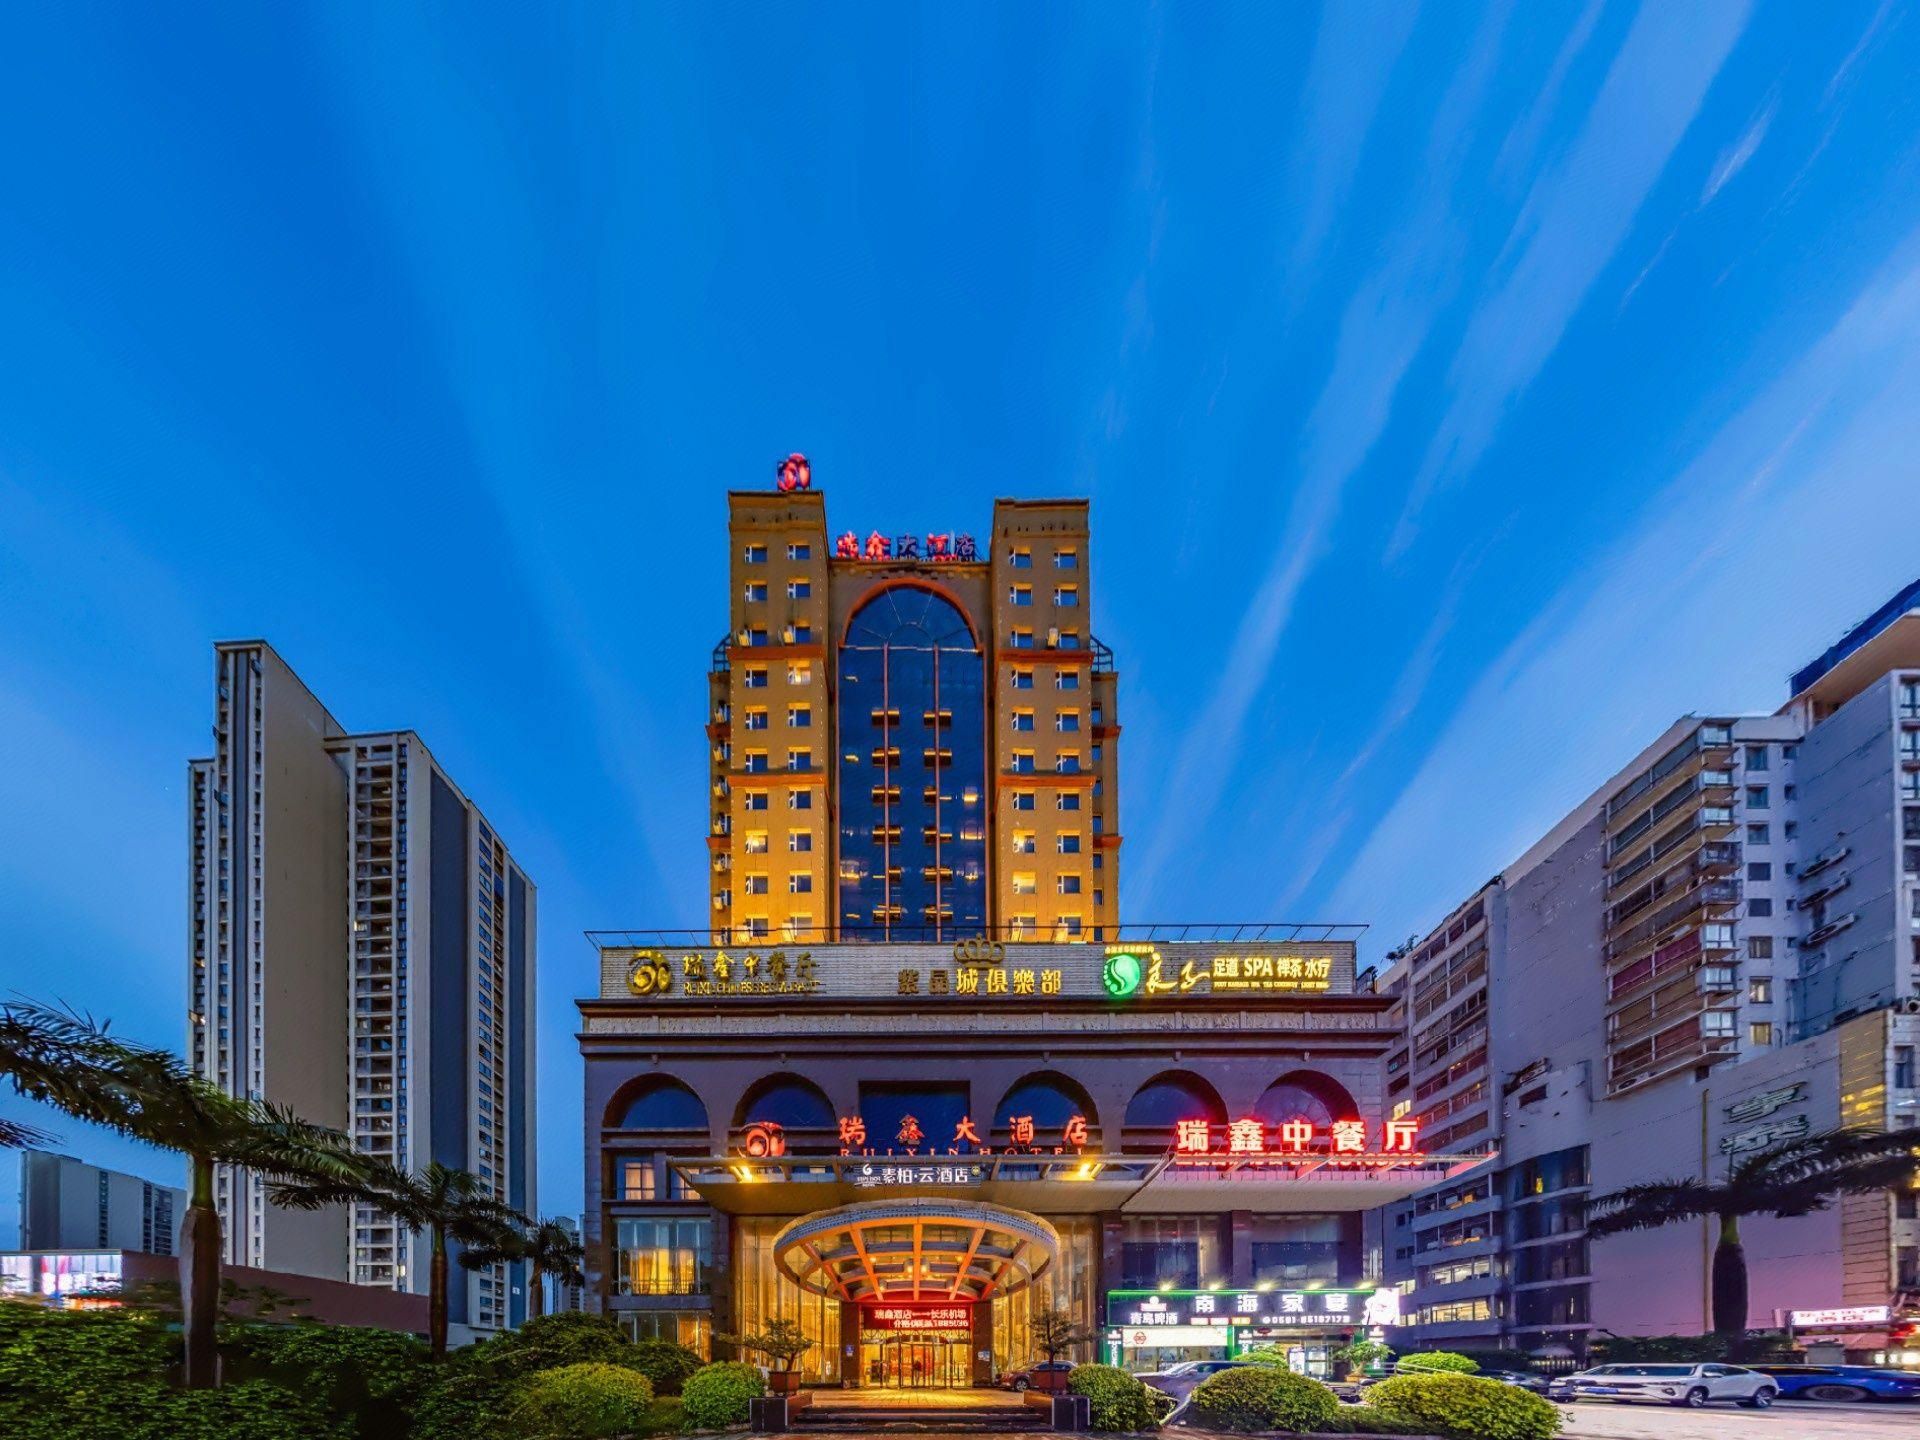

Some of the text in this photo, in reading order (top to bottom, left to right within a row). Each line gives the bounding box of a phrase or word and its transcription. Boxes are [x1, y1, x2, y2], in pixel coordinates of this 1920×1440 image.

[1213, 957, 1239, 976] 足道
[1243, 957, 1273, 976] SPA
[839, 1115, 1088, 1145] 瑞鑫大酒店
[1177, 1119, 1419, 1151] 瑞鑫中餐厅
[1130, 1312, 1178, 1325] 青岛啤酒
